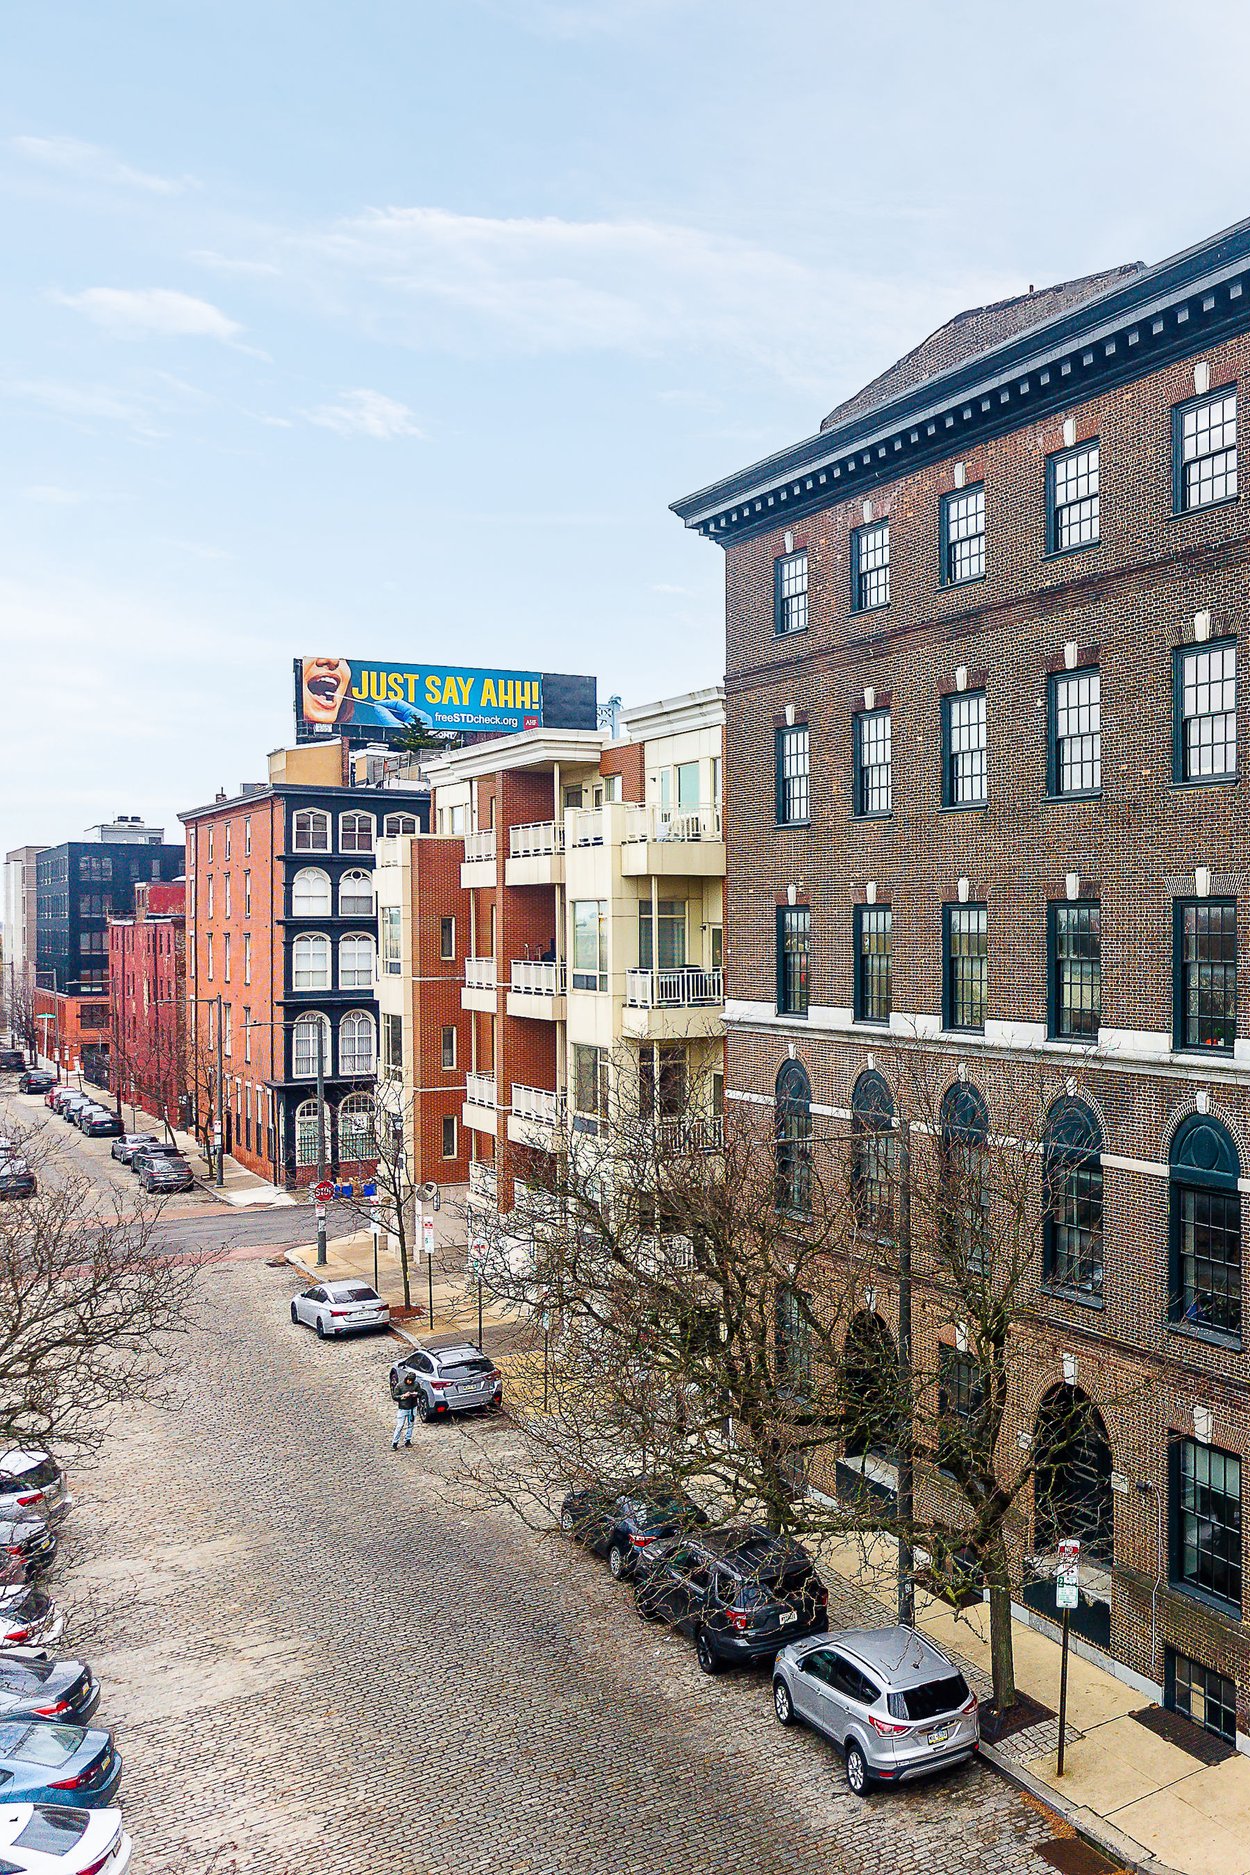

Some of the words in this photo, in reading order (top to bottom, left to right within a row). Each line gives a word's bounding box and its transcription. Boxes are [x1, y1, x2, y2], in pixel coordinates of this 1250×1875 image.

[351, 670, 420, 702] JUST
[425, 675, 475, 706] SAY
[480, 678, 540, 710] AHH!
[435, 712, 518, 728] freeSTDcheck.org
